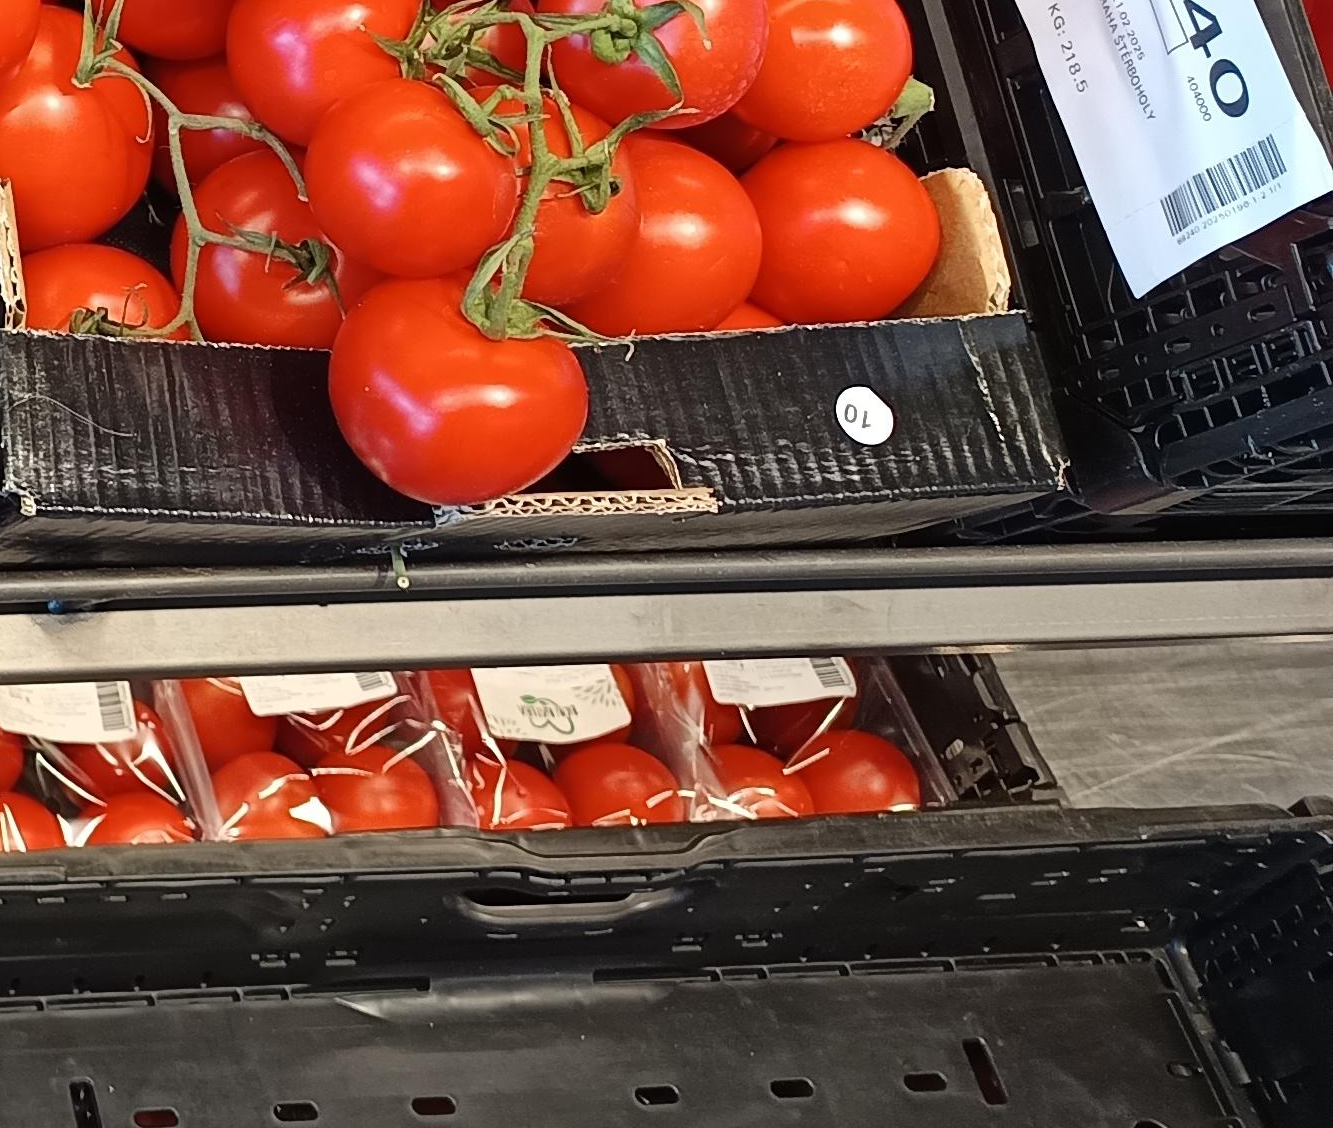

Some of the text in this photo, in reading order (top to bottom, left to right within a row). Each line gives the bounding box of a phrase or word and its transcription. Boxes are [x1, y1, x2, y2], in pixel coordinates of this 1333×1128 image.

[1048, 3, 1088, 92] KG: 218.5
[1188, 76, 1211, 121] 404000
